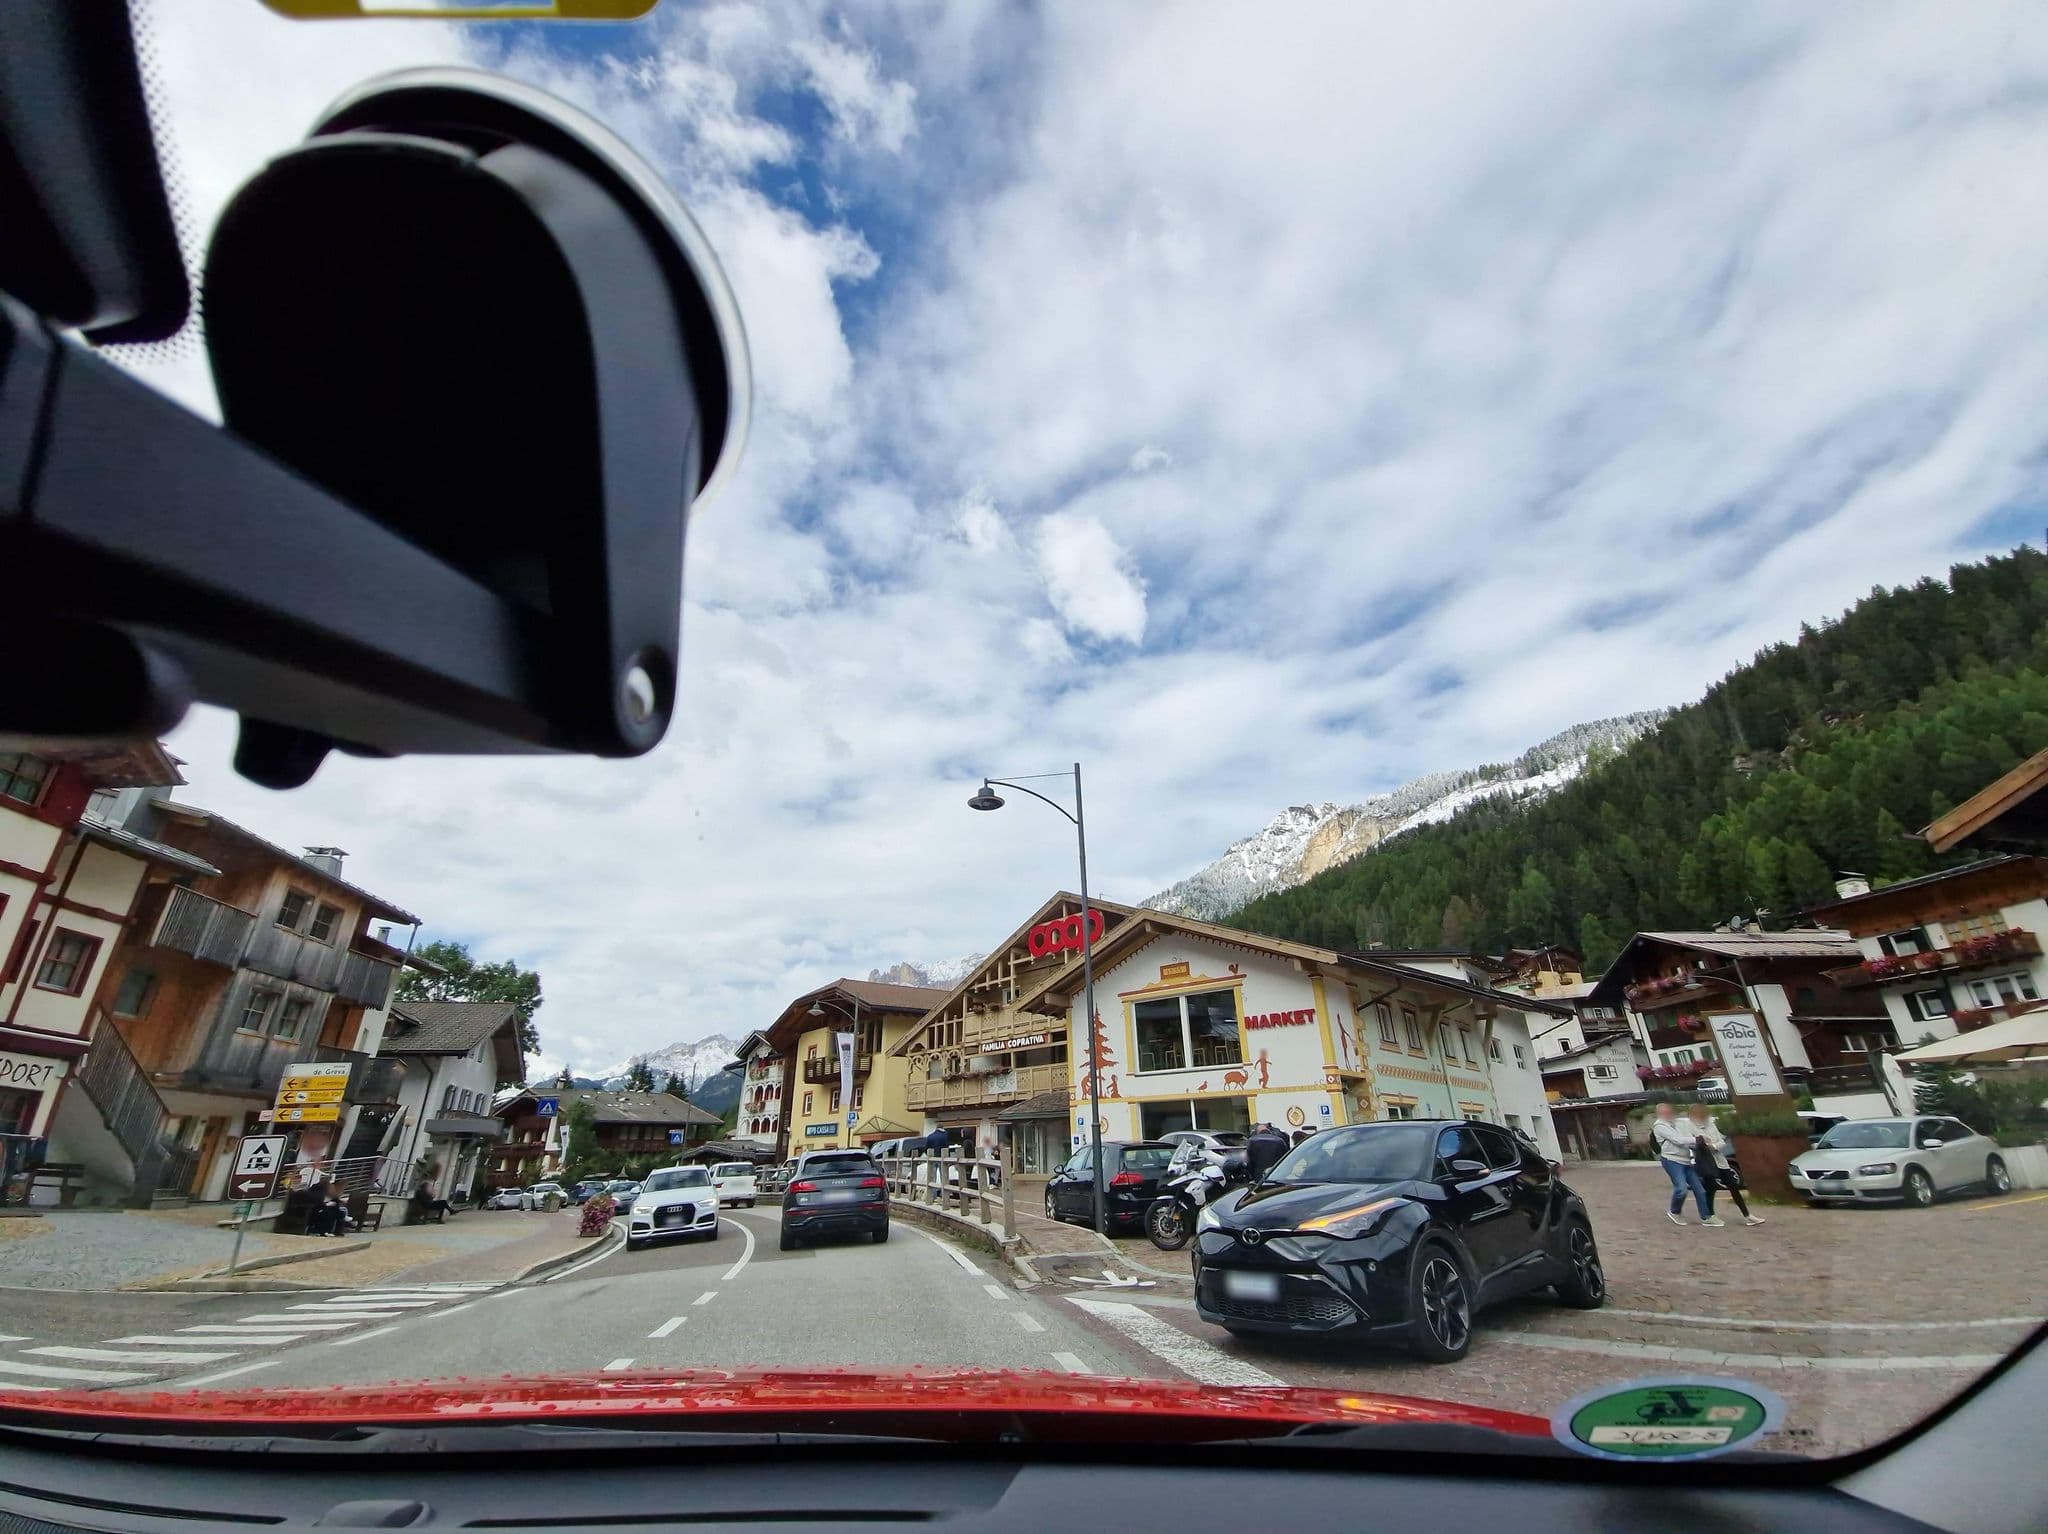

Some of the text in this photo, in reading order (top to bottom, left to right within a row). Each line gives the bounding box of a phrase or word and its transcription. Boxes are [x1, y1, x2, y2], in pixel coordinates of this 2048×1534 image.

[1244, 1008, 1316, 1030] MARKET
[982, 1034, 1044, 1053] FAMILIA COPRATIVA
[0, 1057, 54, 1086] PORT
